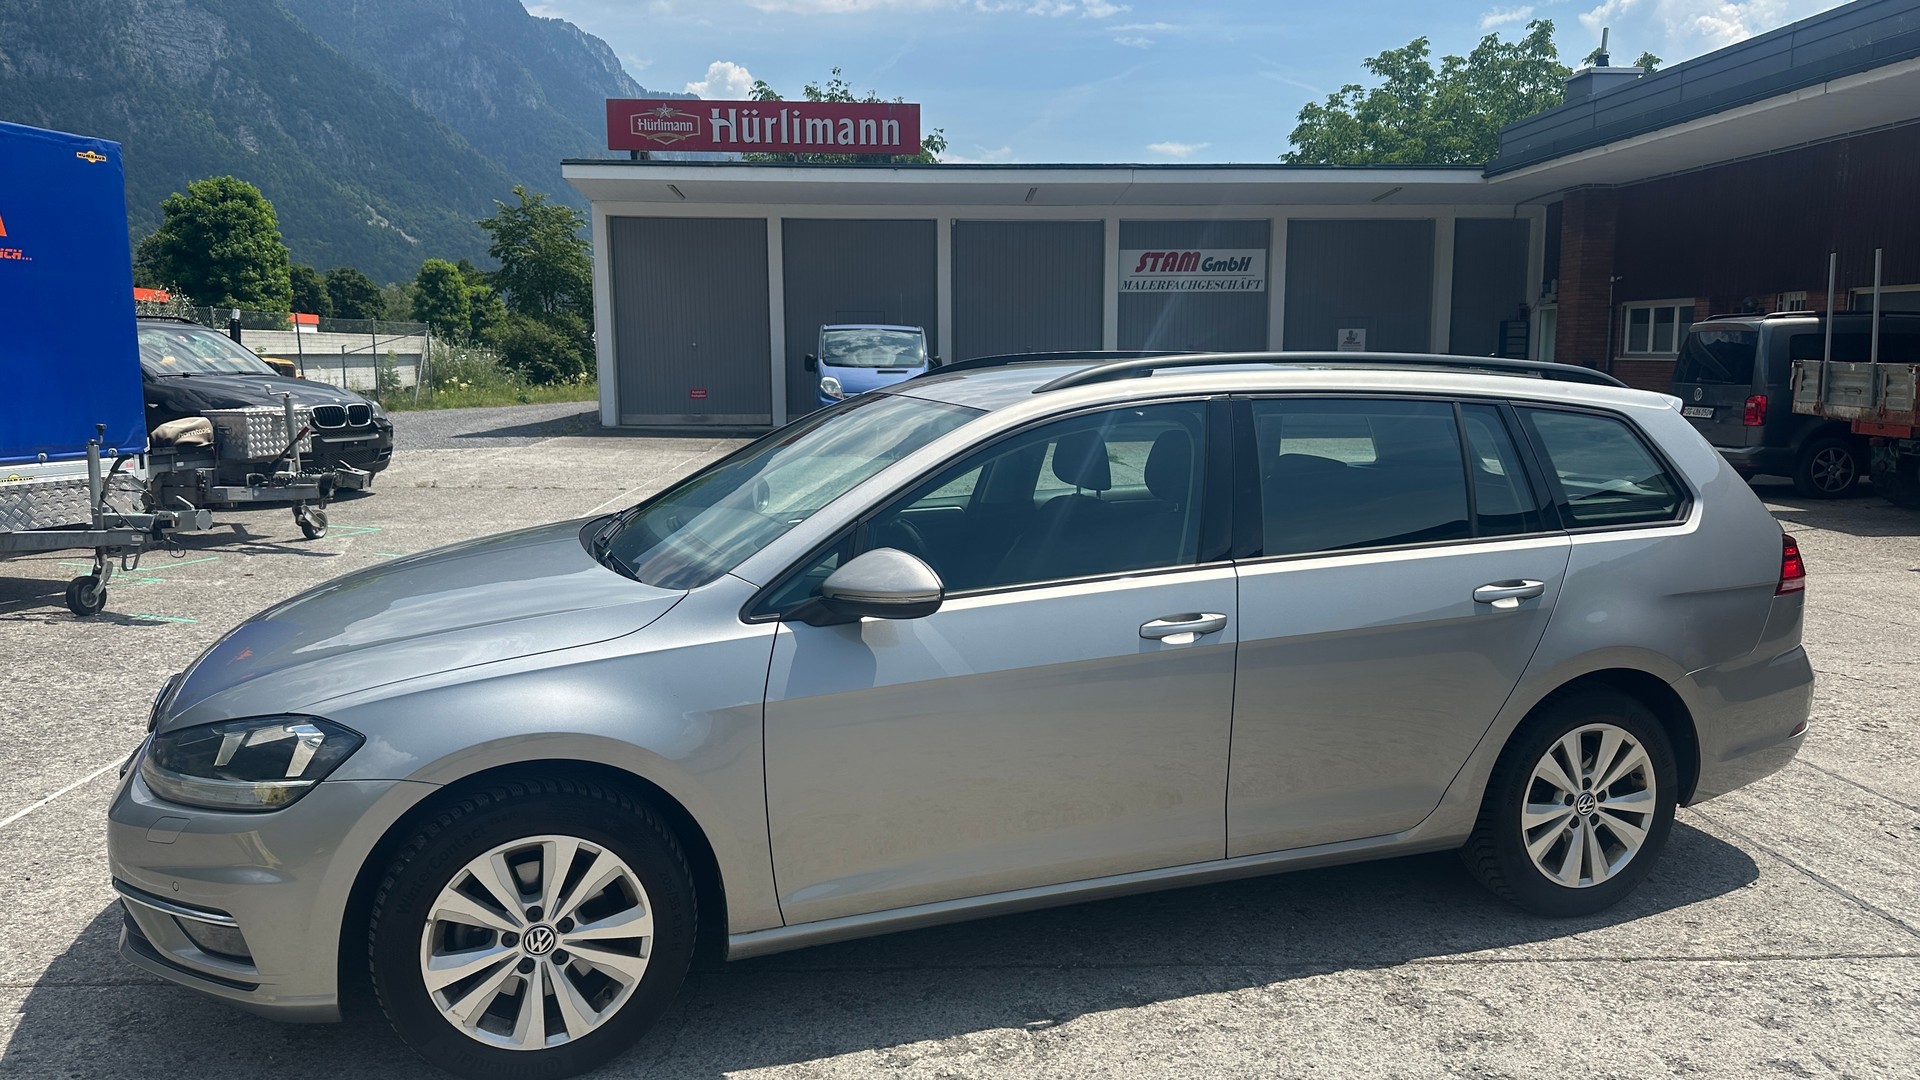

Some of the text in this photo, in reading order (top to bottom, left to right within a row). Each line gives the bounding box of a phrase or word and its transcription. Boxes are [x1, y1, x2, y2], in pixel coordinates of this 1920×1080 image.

[637, 118, 693, 132] Hürlimann
[708, 108, 900, 145] Hürlimann
[1135, 251, 1252, 272] STAM GmbH
[1122, 277, 1263, 290] MALERFACHGESCHÄFT
[396, 824, 488, 914] WinterContact
